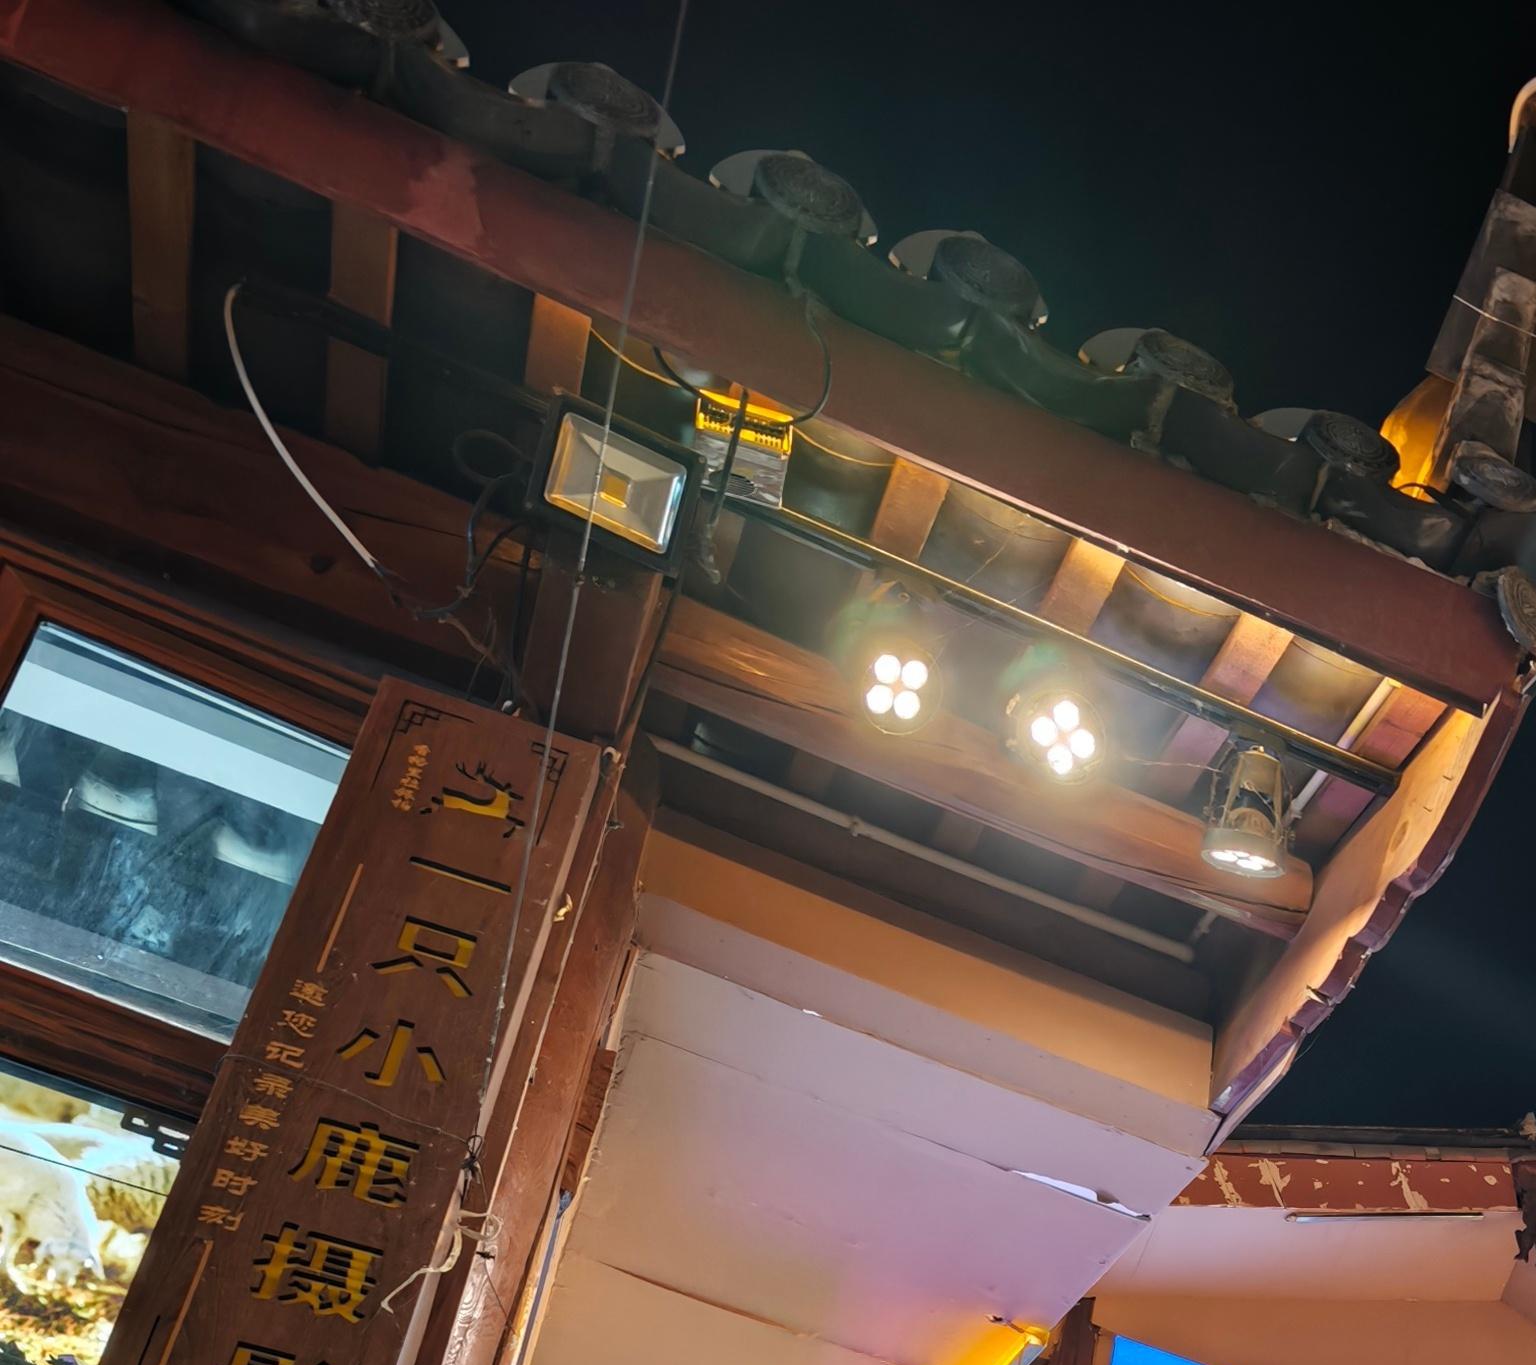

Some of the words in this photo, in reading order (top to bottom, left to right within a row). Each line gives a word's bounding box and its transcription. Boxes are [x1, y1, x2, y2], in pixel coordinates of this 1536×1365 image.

[198, 978, 330, 1232] 邀您记录美好时刻
